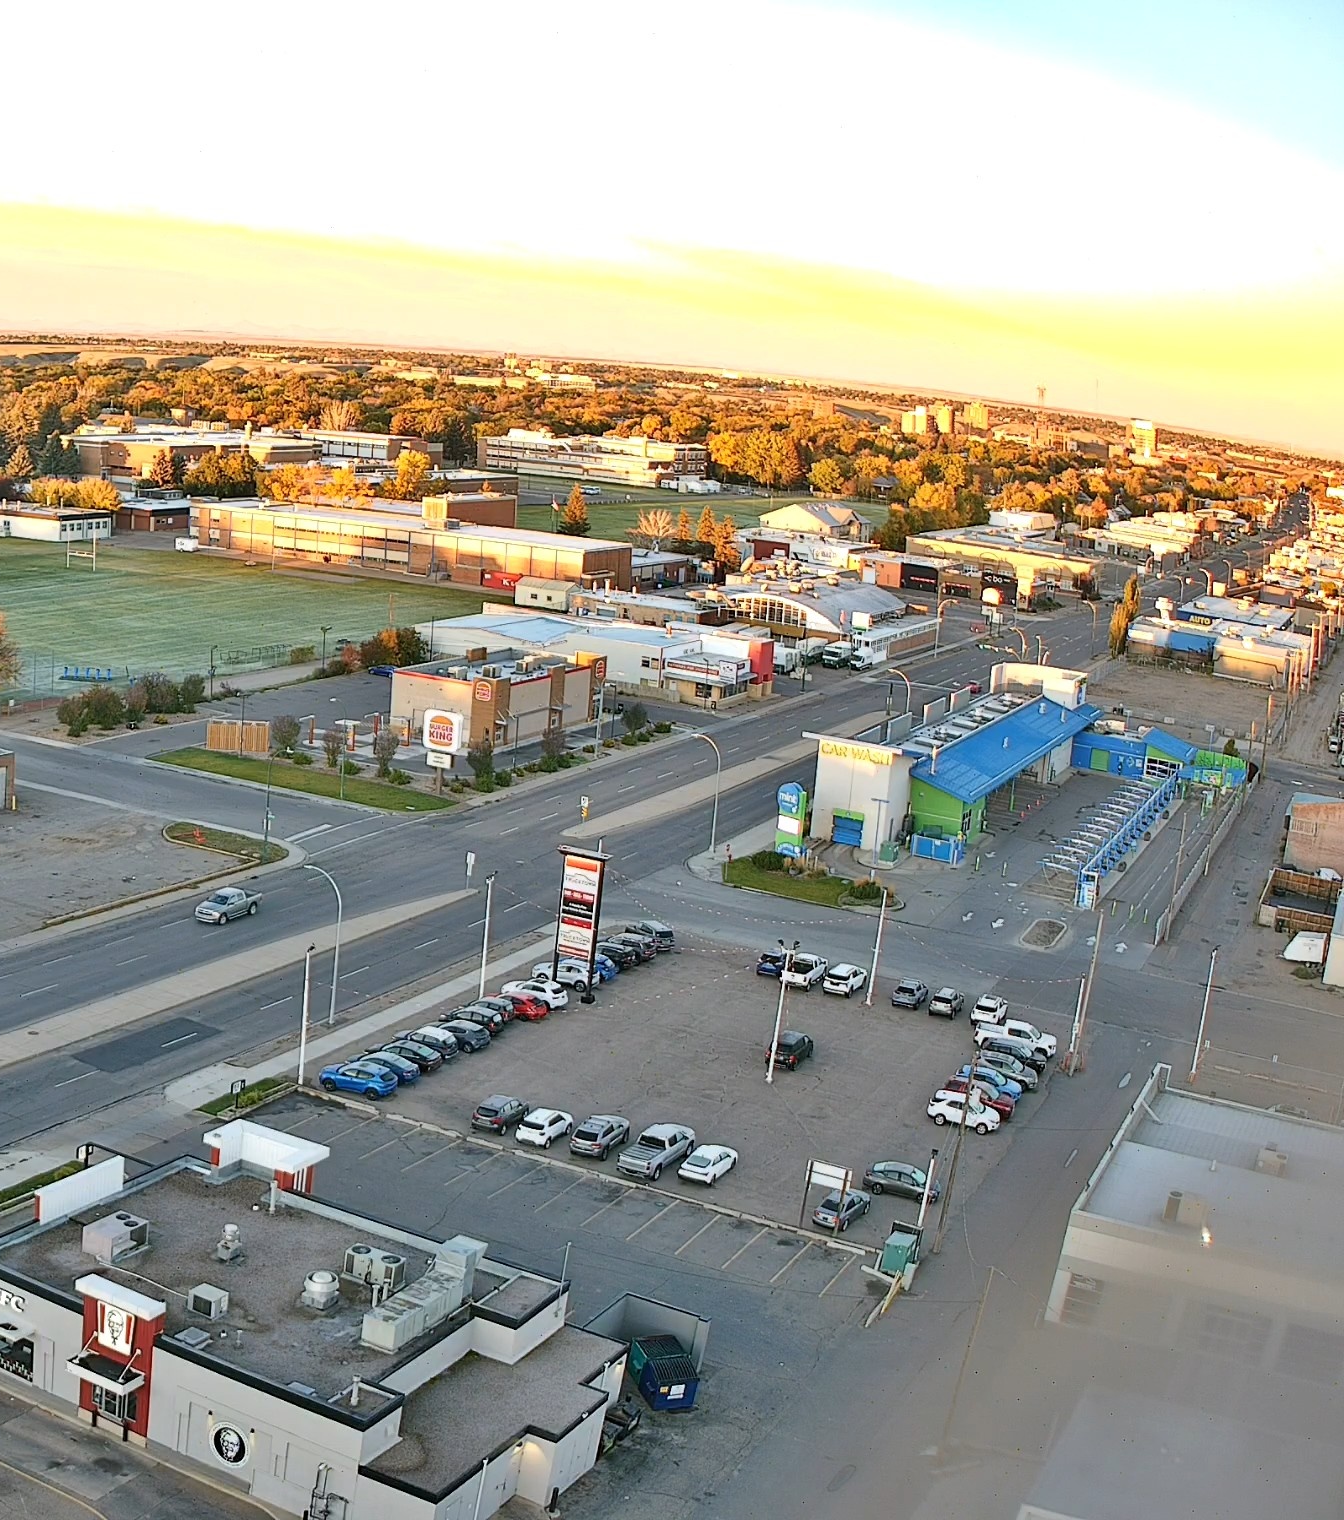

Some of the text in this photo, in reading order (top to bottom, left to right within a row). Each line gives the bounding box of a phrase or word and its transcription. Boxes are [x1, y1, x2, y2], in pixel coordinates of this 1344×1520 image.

[1188, 615, 1211, 625] AUTO
[429, 723, 453, 733] BURGER
[429, 730, 453, 742] KING
[821, 742, 891, 766] CAR WASH
[779, 791, 797, 804] mint
